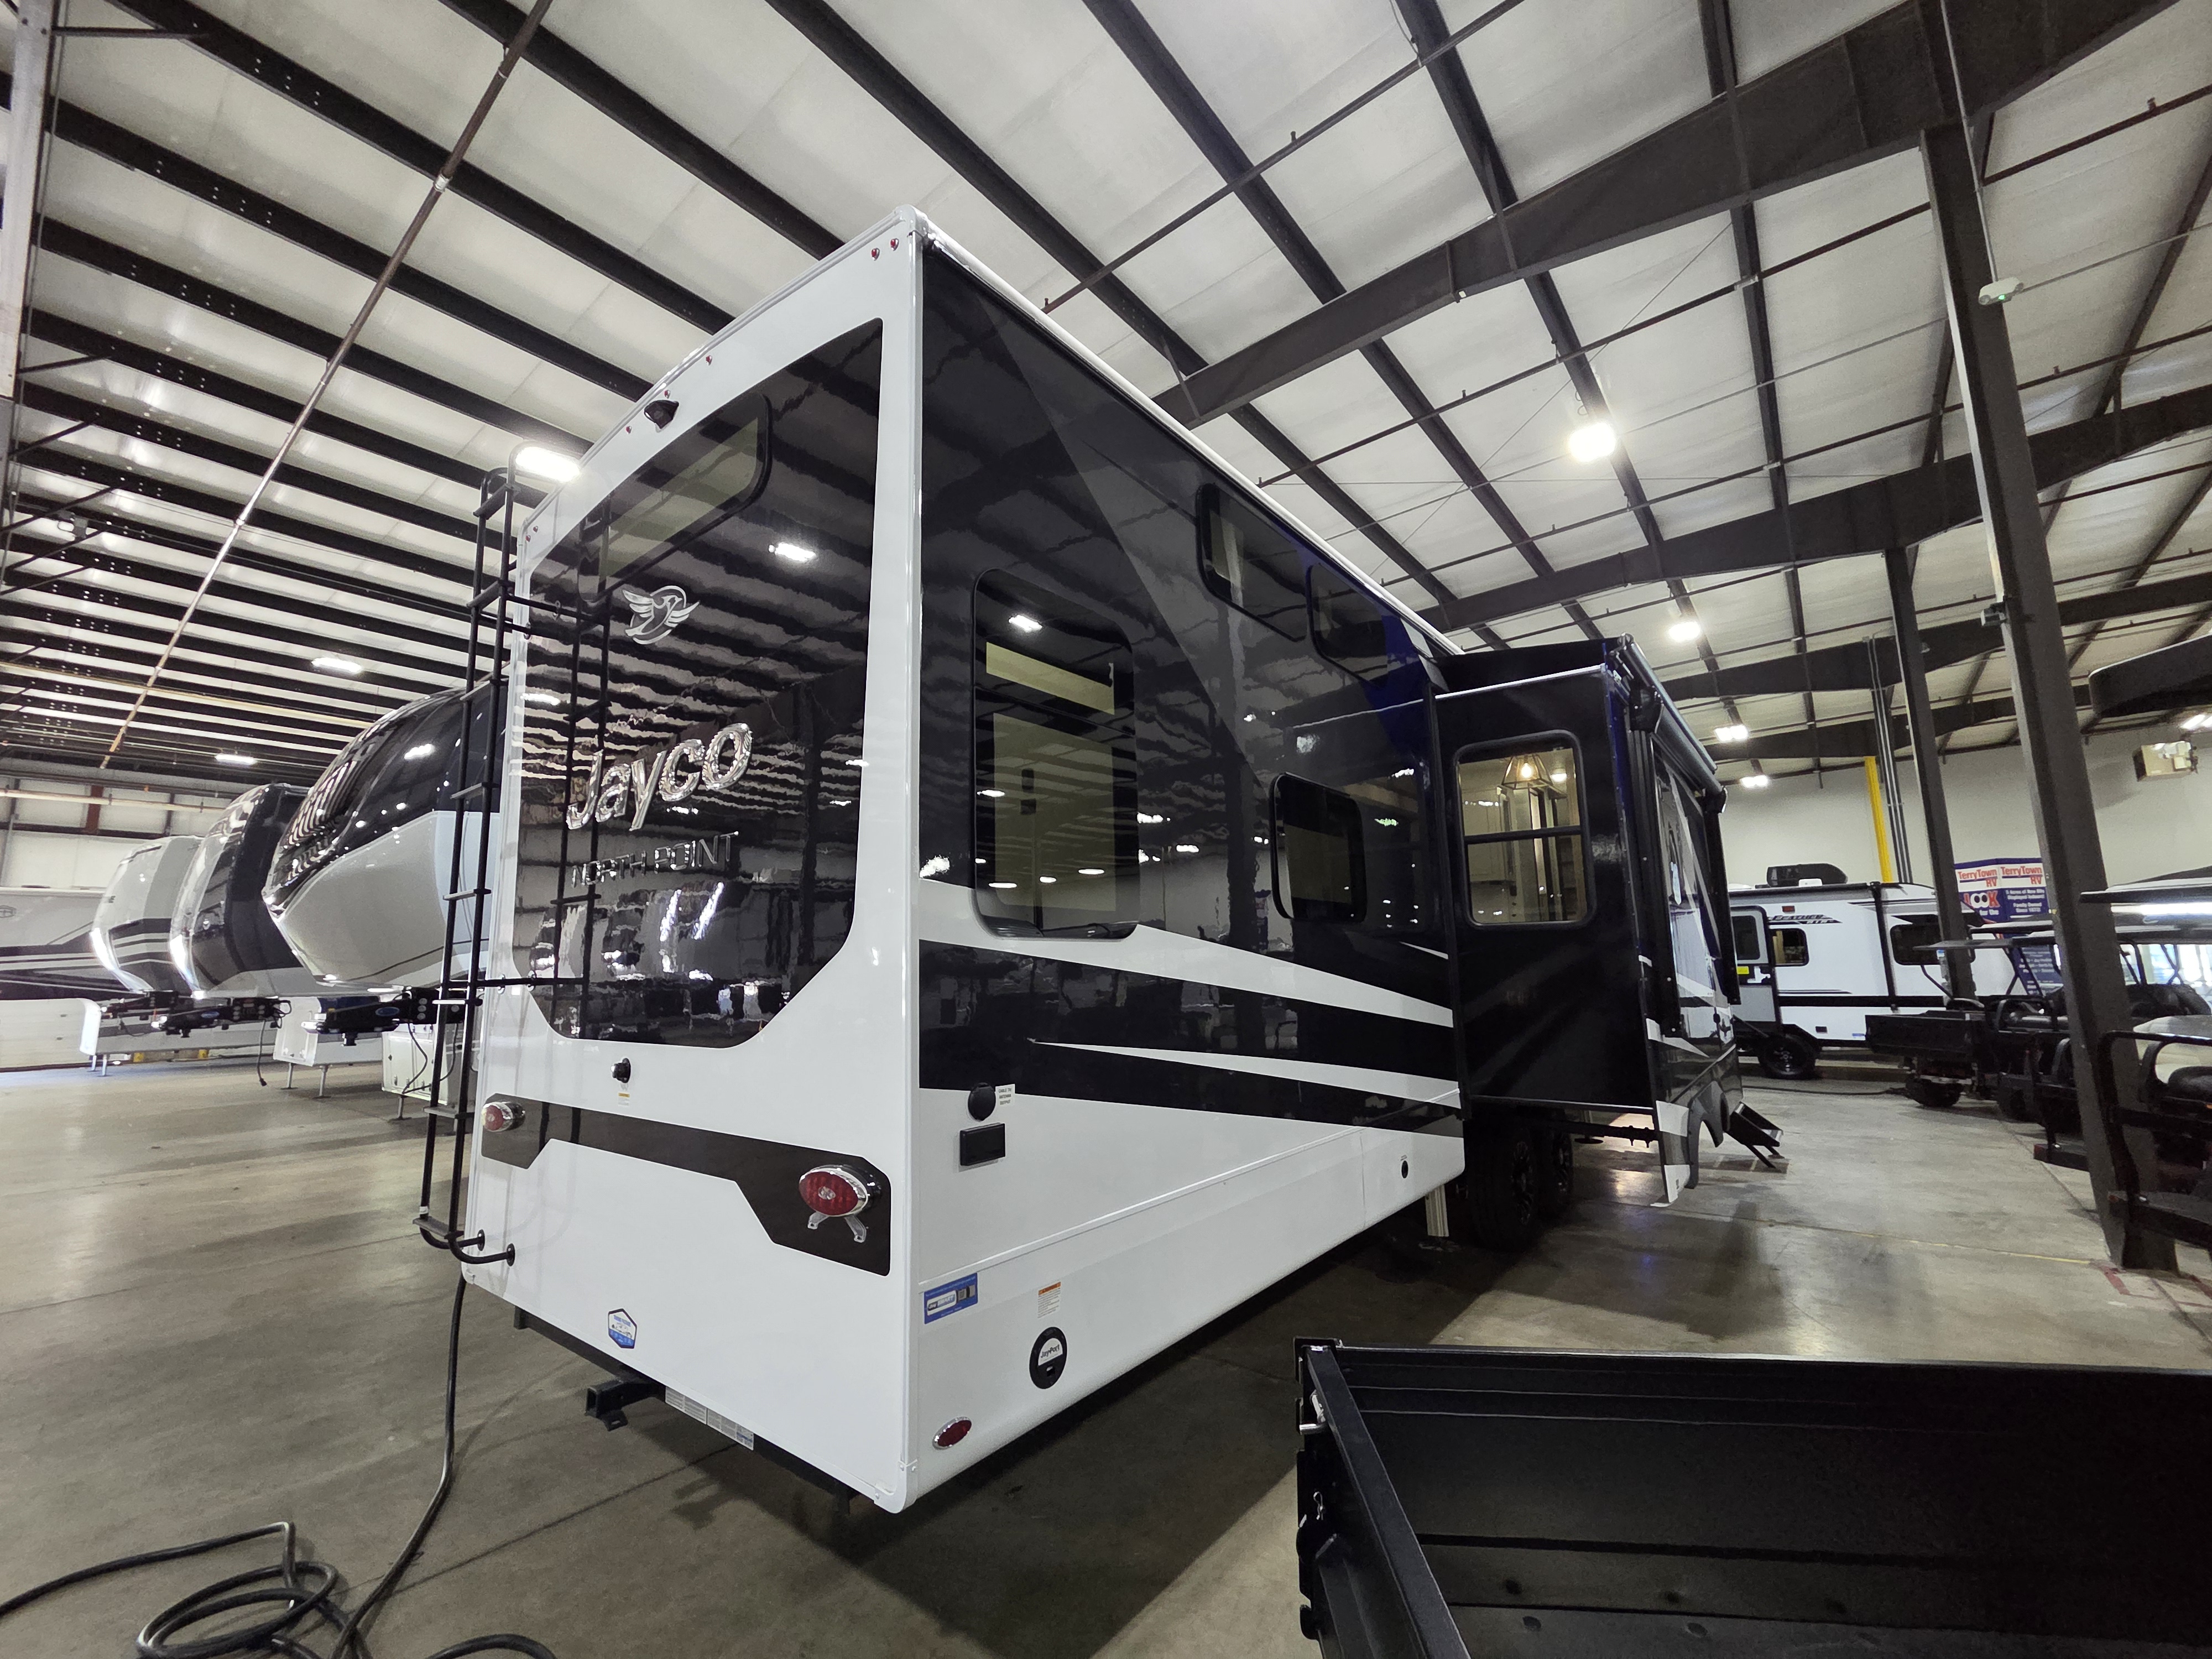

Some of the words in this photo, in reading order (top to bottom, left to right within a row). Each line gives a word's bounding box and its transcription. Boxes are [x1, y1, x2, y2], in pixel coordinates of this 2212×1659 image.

[566, 723, 754, 831] Jayco
[571, 850, 646, 888] NORTH
[654, 831, 739, 874] POINT
[1958, 869, 1997, 881] TerryTown
[2000, 865, 2042, 877] TerryTown
[1985, 878, 1997, 887] RV
[2030, 875, 2042, 885] RV
